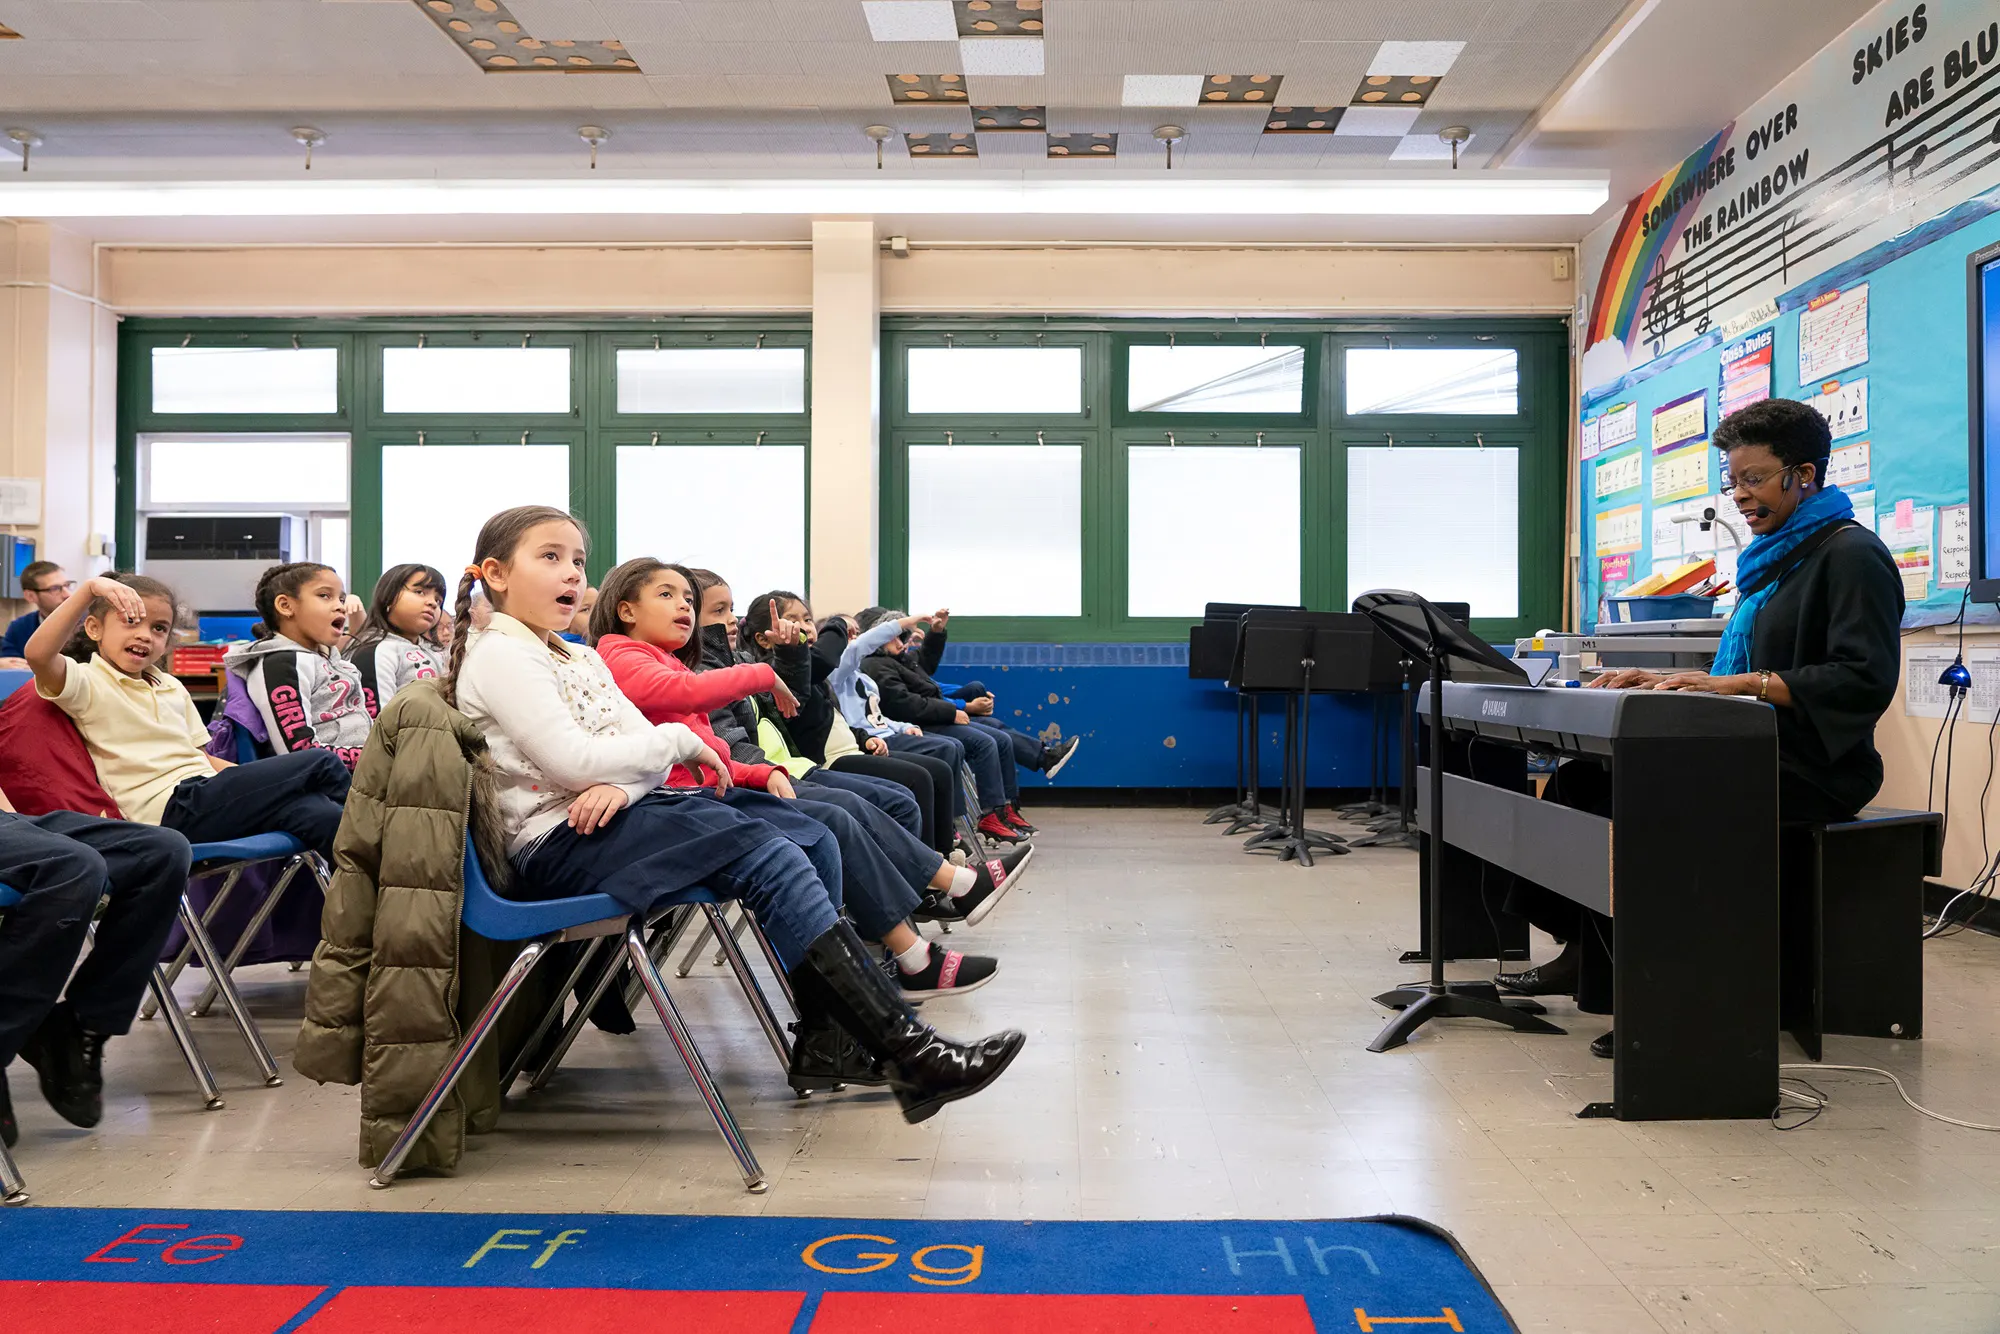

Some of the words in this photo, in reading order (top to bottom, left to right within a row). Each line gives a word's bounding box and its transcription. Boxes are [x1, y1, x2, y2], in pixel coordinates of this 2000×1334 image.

[1852, 3, 1927, 85] SKIES
[1885, 66, 1934, 128] ARE
[1944, 22, 1998, 89] BLU
[1642, 147, 1735, 237] SOMEWHERE
[1746, 103, 1797, 160] OVER
[1683, 214, 1712, 253] THE
[1717, 148, 1809, 233] RAINBOW
[1745, 331, 1772, 354] Rules
[1582, 641, 1597, 649] M1
[271, 685, 306, 740] GIRL
[84, 1224, 244, 1265] Ee
[464, 1228, 587, 1268] Ff
[801, 1233, 984, 1286] Gg
[1221, 1236, 1381, 1276] Hh
